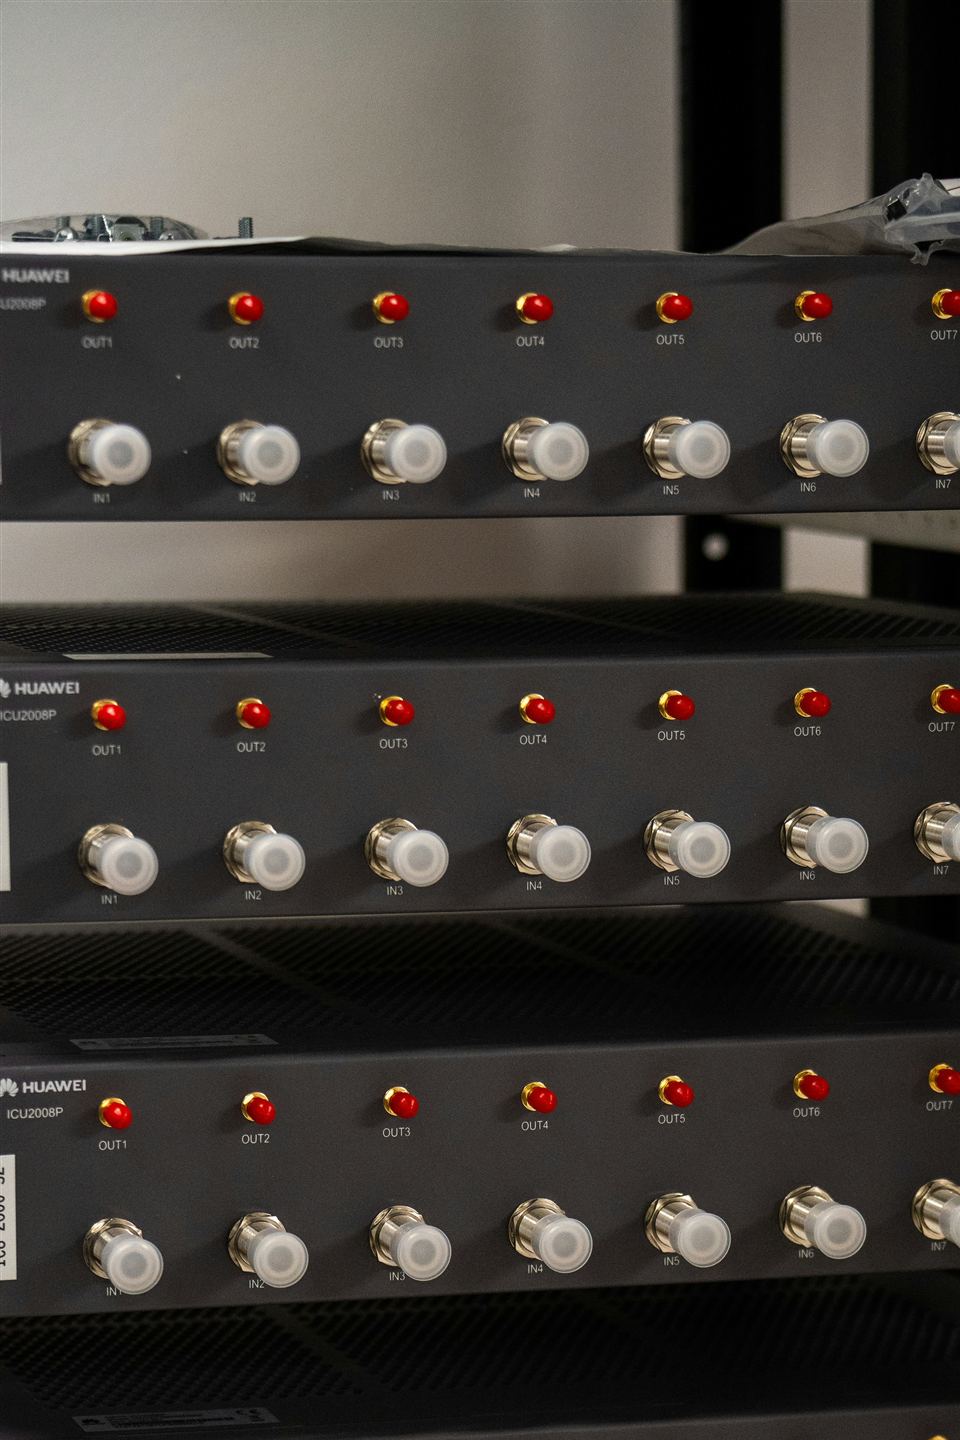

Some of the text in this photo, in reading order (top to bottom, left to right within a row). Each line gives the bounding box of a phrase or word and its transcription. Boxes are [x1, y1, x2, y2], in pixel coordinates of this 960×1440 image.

[2, 269, 70, 284] HUAWEI
[656, 334, 684, 345] OUT5
[794, 332, 822, 343] OUT6
[930, 330, 958, 340] OUT7
[82, 336, 112, 348] OUT1
[229, 337, 259, 349] OUT2
[374, 336, 403, 348] OUT3
[516, 336, 544, 347] OUT4
[800, 482, 816, 492] IN6
[936, 479, 951, 488] IN7
[382, 490, 399, 500] IN3
[524, 488, 540, 498] IN4
[663, 485, 679, 495] IN5
[93, 493, 109, 503] IN1
[239, 492, 256, 502] IN2
[14, 682, 79, 695] HUAWEI
[0, 710, 57, 722] ICU2008P
[794, 726, 821, 736] OUT6
[928, 722, 955, 732] OUT7
[519, 734, 547, 745] OUT4
[658, 730, 685, 741] OUT5
[237, 741, 266, 752] OUT2
[379, 738, 408, 749] OUT3
[92, 744, 121, 756] OUT1
[800, 871, 815, 880] IN6
[934, 866, 948, 874] IN7
[527, 881, 542, 890] IN4
[664, 876, 679, 885] IN5
[245, 890, 261, 900] IN2
[387, 886, 403, 895] IN3
[101, 895, 117, 904] IN1
[22, 1079, 86, 1093] HUAWEI
[926, 1100, 953, 1111] OUT7
[7, 1107, 63, 1119] ICU2008P
[793, 1107, 820, 1118] OUT6
[658, 1113, 685, 1124] OUT5
[521, 1120, 548, 1131] OUT4
[382, 1127, 411, 1138] OUT3
[241, 1133, 270, 1144] OUT2
[98, 1140, 126, 1151] OUT1
[930, 1240, 946, 1252] IN7
[799, 1248, 815, 1260] IN6
[663, 1255, 680, 1266] IN5
[528, 1263, 544, 1274] IN4
[388, 1270, 405, 1282] IN3
[248, 1278, 265, 1290] IN2
